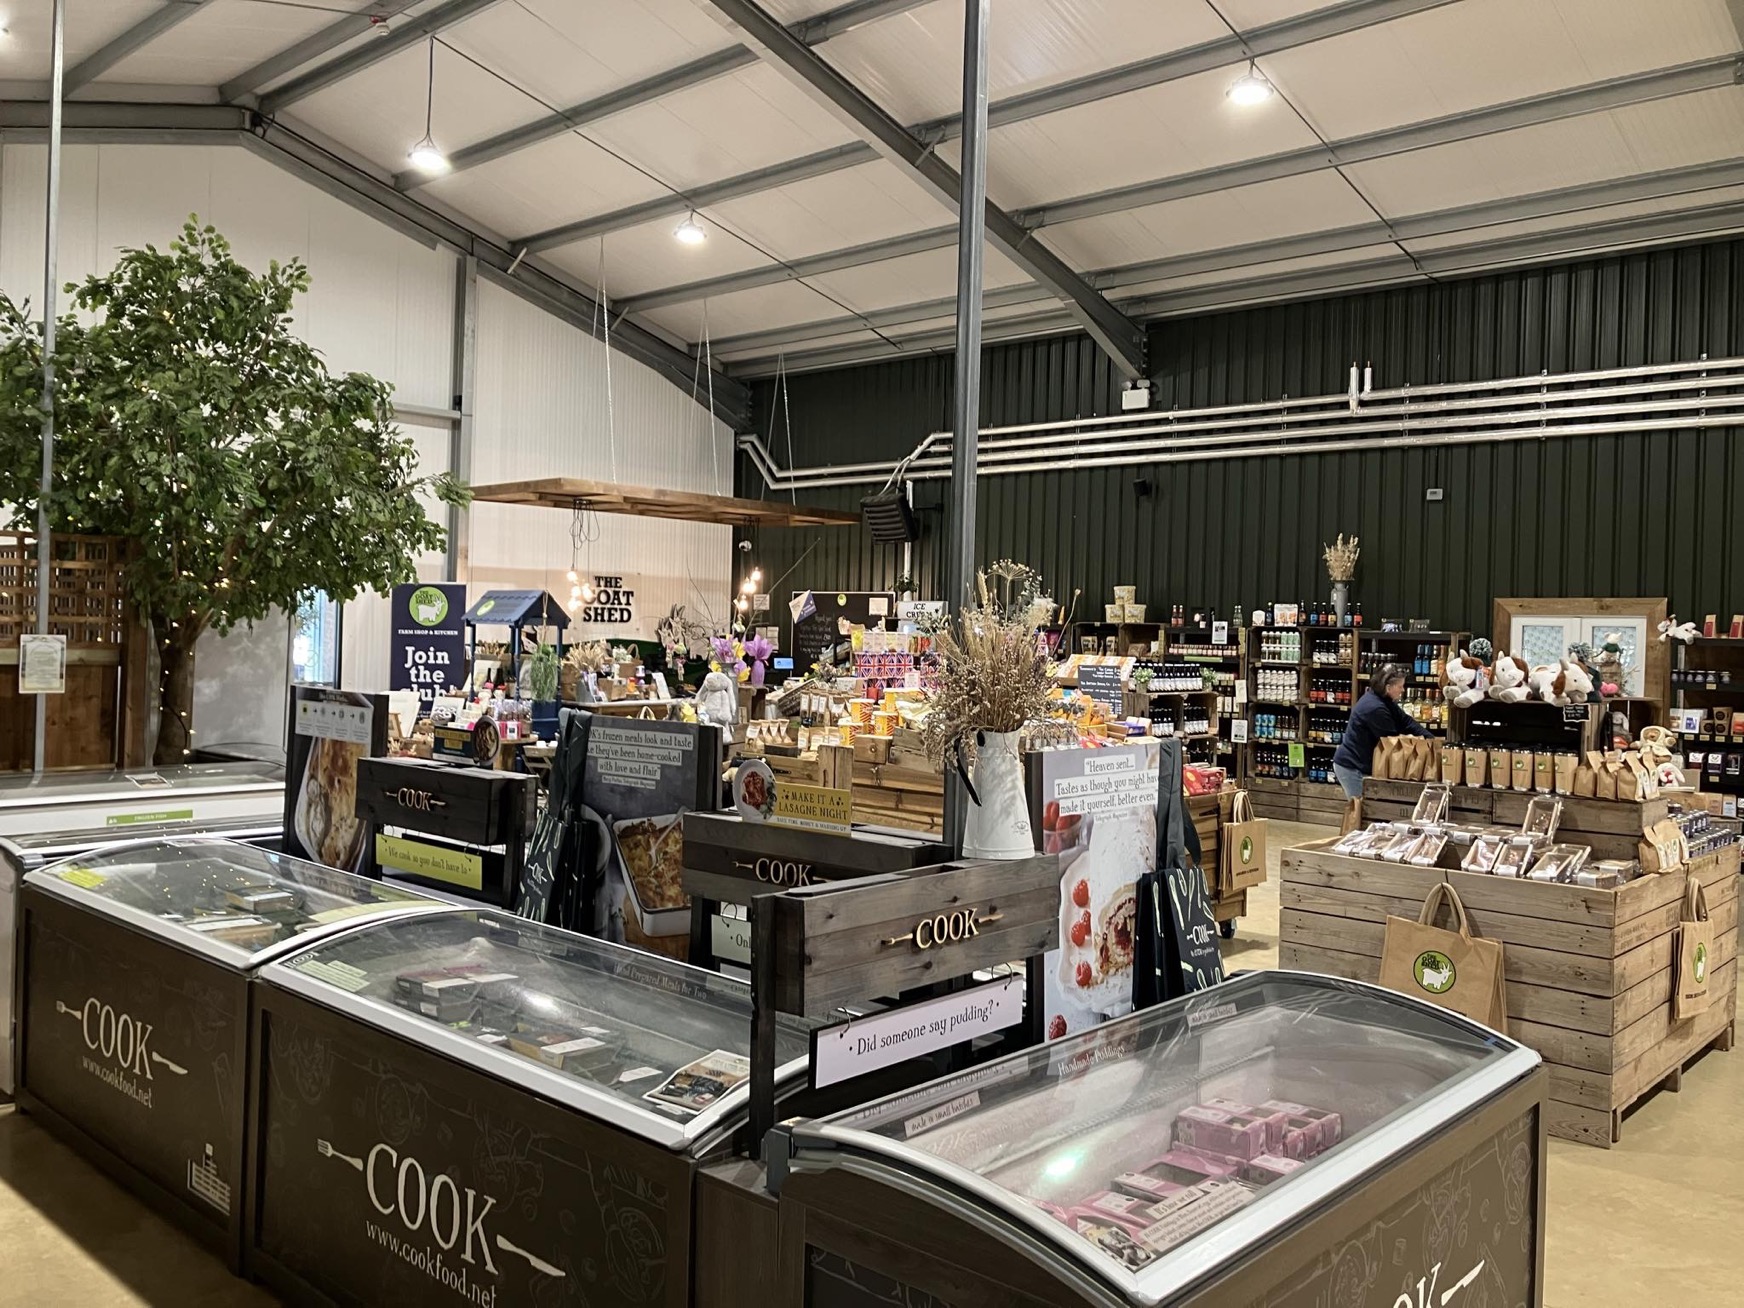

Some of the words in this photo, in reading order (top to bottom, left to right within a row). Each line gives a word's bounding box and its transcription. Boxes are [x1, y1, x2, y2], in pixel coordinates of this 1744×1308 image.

[594, 576, 622, 589] THE
[583, 606, 632, 623] SHED
[404, 646, 450, 668] Join
[409, 665, 445, 683] the
[603, 730, 623, 740] frozen
[624, 732, 643, 742] meals
[644, 733, 658, 744] look
[660, 735, 672, 746] and
[674, 737, 692, 748] taste
[595, 745, 619, 759] they've
[620, 748, 636, 758] been
[637, 749, 681, 762] home-cooked
[599, 761, 613, 771] with
[614, 762, 627, 773] love
[629, 764, 641, 775] and
[1056, 782, 1079, 796] Tastes
[1080, 784, 1088, 792] as
[1089, 777, 1113, 793] though
[1114, 778, 1127, 792] you
[1128, 773, 1145, 790] might
[397, 787, 432, 811] COOK
[791, 791, 815, 804] MAKE
[817, 795, 826, 805] IT
[829, 797, 836, 806] A
[1060, 799, 1079, 814] made
[1079, 799, 1085, 811] it
[1087, 795, 1117, 814] yourself,
[1118, 794, 1138, 806] better
[779, 802, 817, 816] LASAGNE
[820, 808, 848, 820] NIGHT
[388, 846, 399, 858] We
[399, 851, 411, 861] cook
[420, 857, 431, 868] you
[432, 856, 444, 869] don't
[445, 861, 460, 873] have
[461, 864, 468, 874] to
[755, 858, 812, 887] COOK
[916, 907, 979, 949] COOK
[631, 966, 660, 986] Prepared
[661, 976, 681, 992] Meals
[682, 982, 692, 995] for
[694, 986, 707, 999] Two
[857, 1034, 877, 1055] Did
[880, 1024, 926, 1049] someone
[929, 1019, 947, 1036] say
[950, 999, 994, 1031] pudding?
[82, 997, 153, 1081] COOK
[1057, 1053, 1095, 1076] Handmade
[1094, 1045, 1125, 1063] Puddings
[82, 1056, 153, 1109] www.cookfood.net
[935, 1107, 951, 1121] small
[366, 1143, 499, 1275] COOK
[366, 1220, 497, 1308] www.cookfood.net
